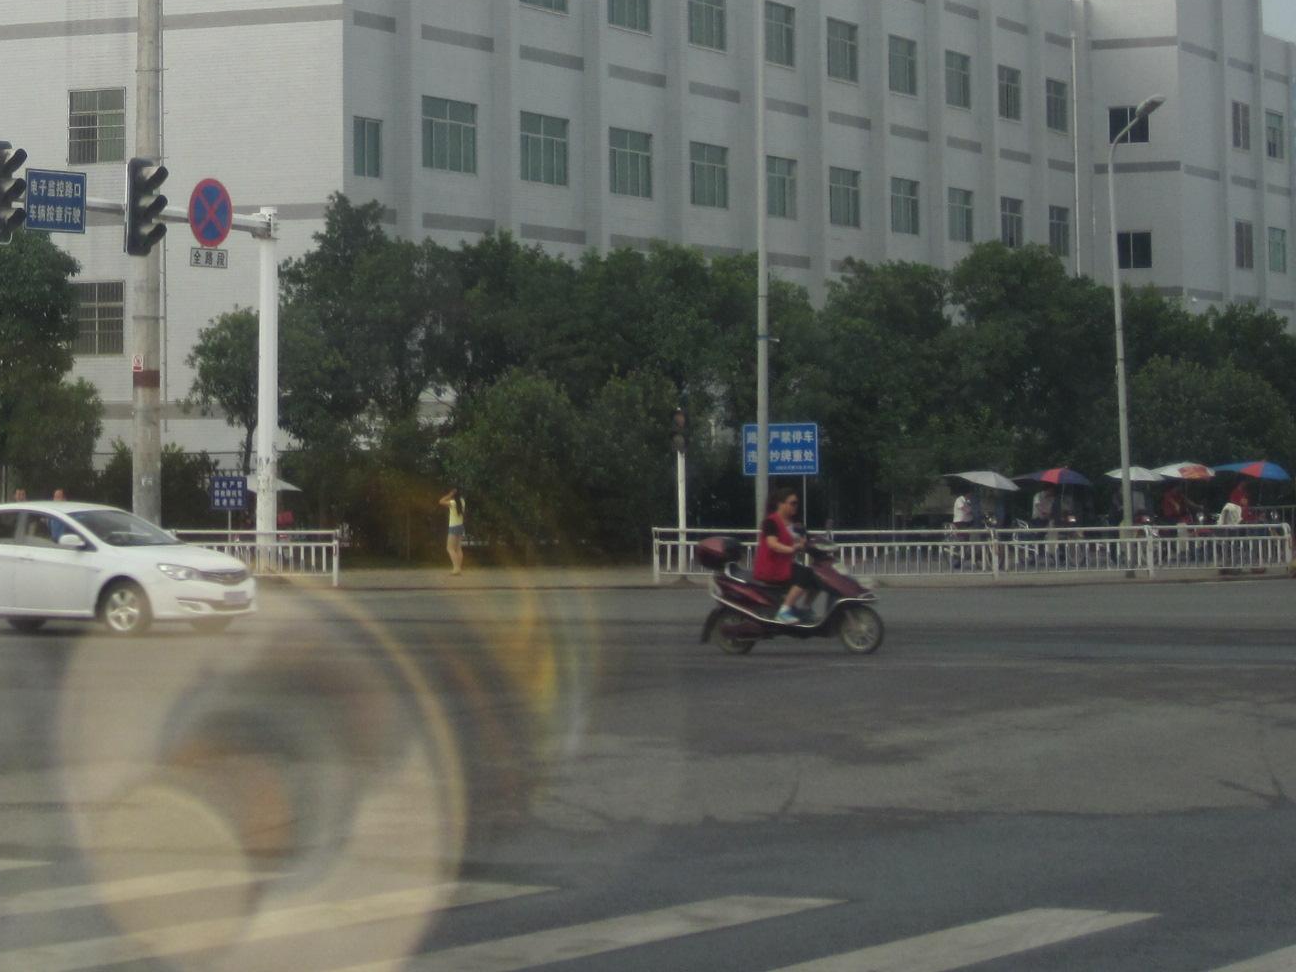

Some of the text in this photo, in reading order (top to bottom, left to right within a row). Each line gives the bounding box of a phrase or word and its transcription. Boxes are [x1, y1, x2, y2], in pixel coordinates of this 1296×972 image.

[30, 179, 81, 198] 电子监控路口
[29, 203, 81, 224] 车辆按章行驶
[193, 250, 225, 267] 全路段
[746, 430, 815, 444] 路严禁停车
[746, 449, 815, 462] 违抄牌重处
